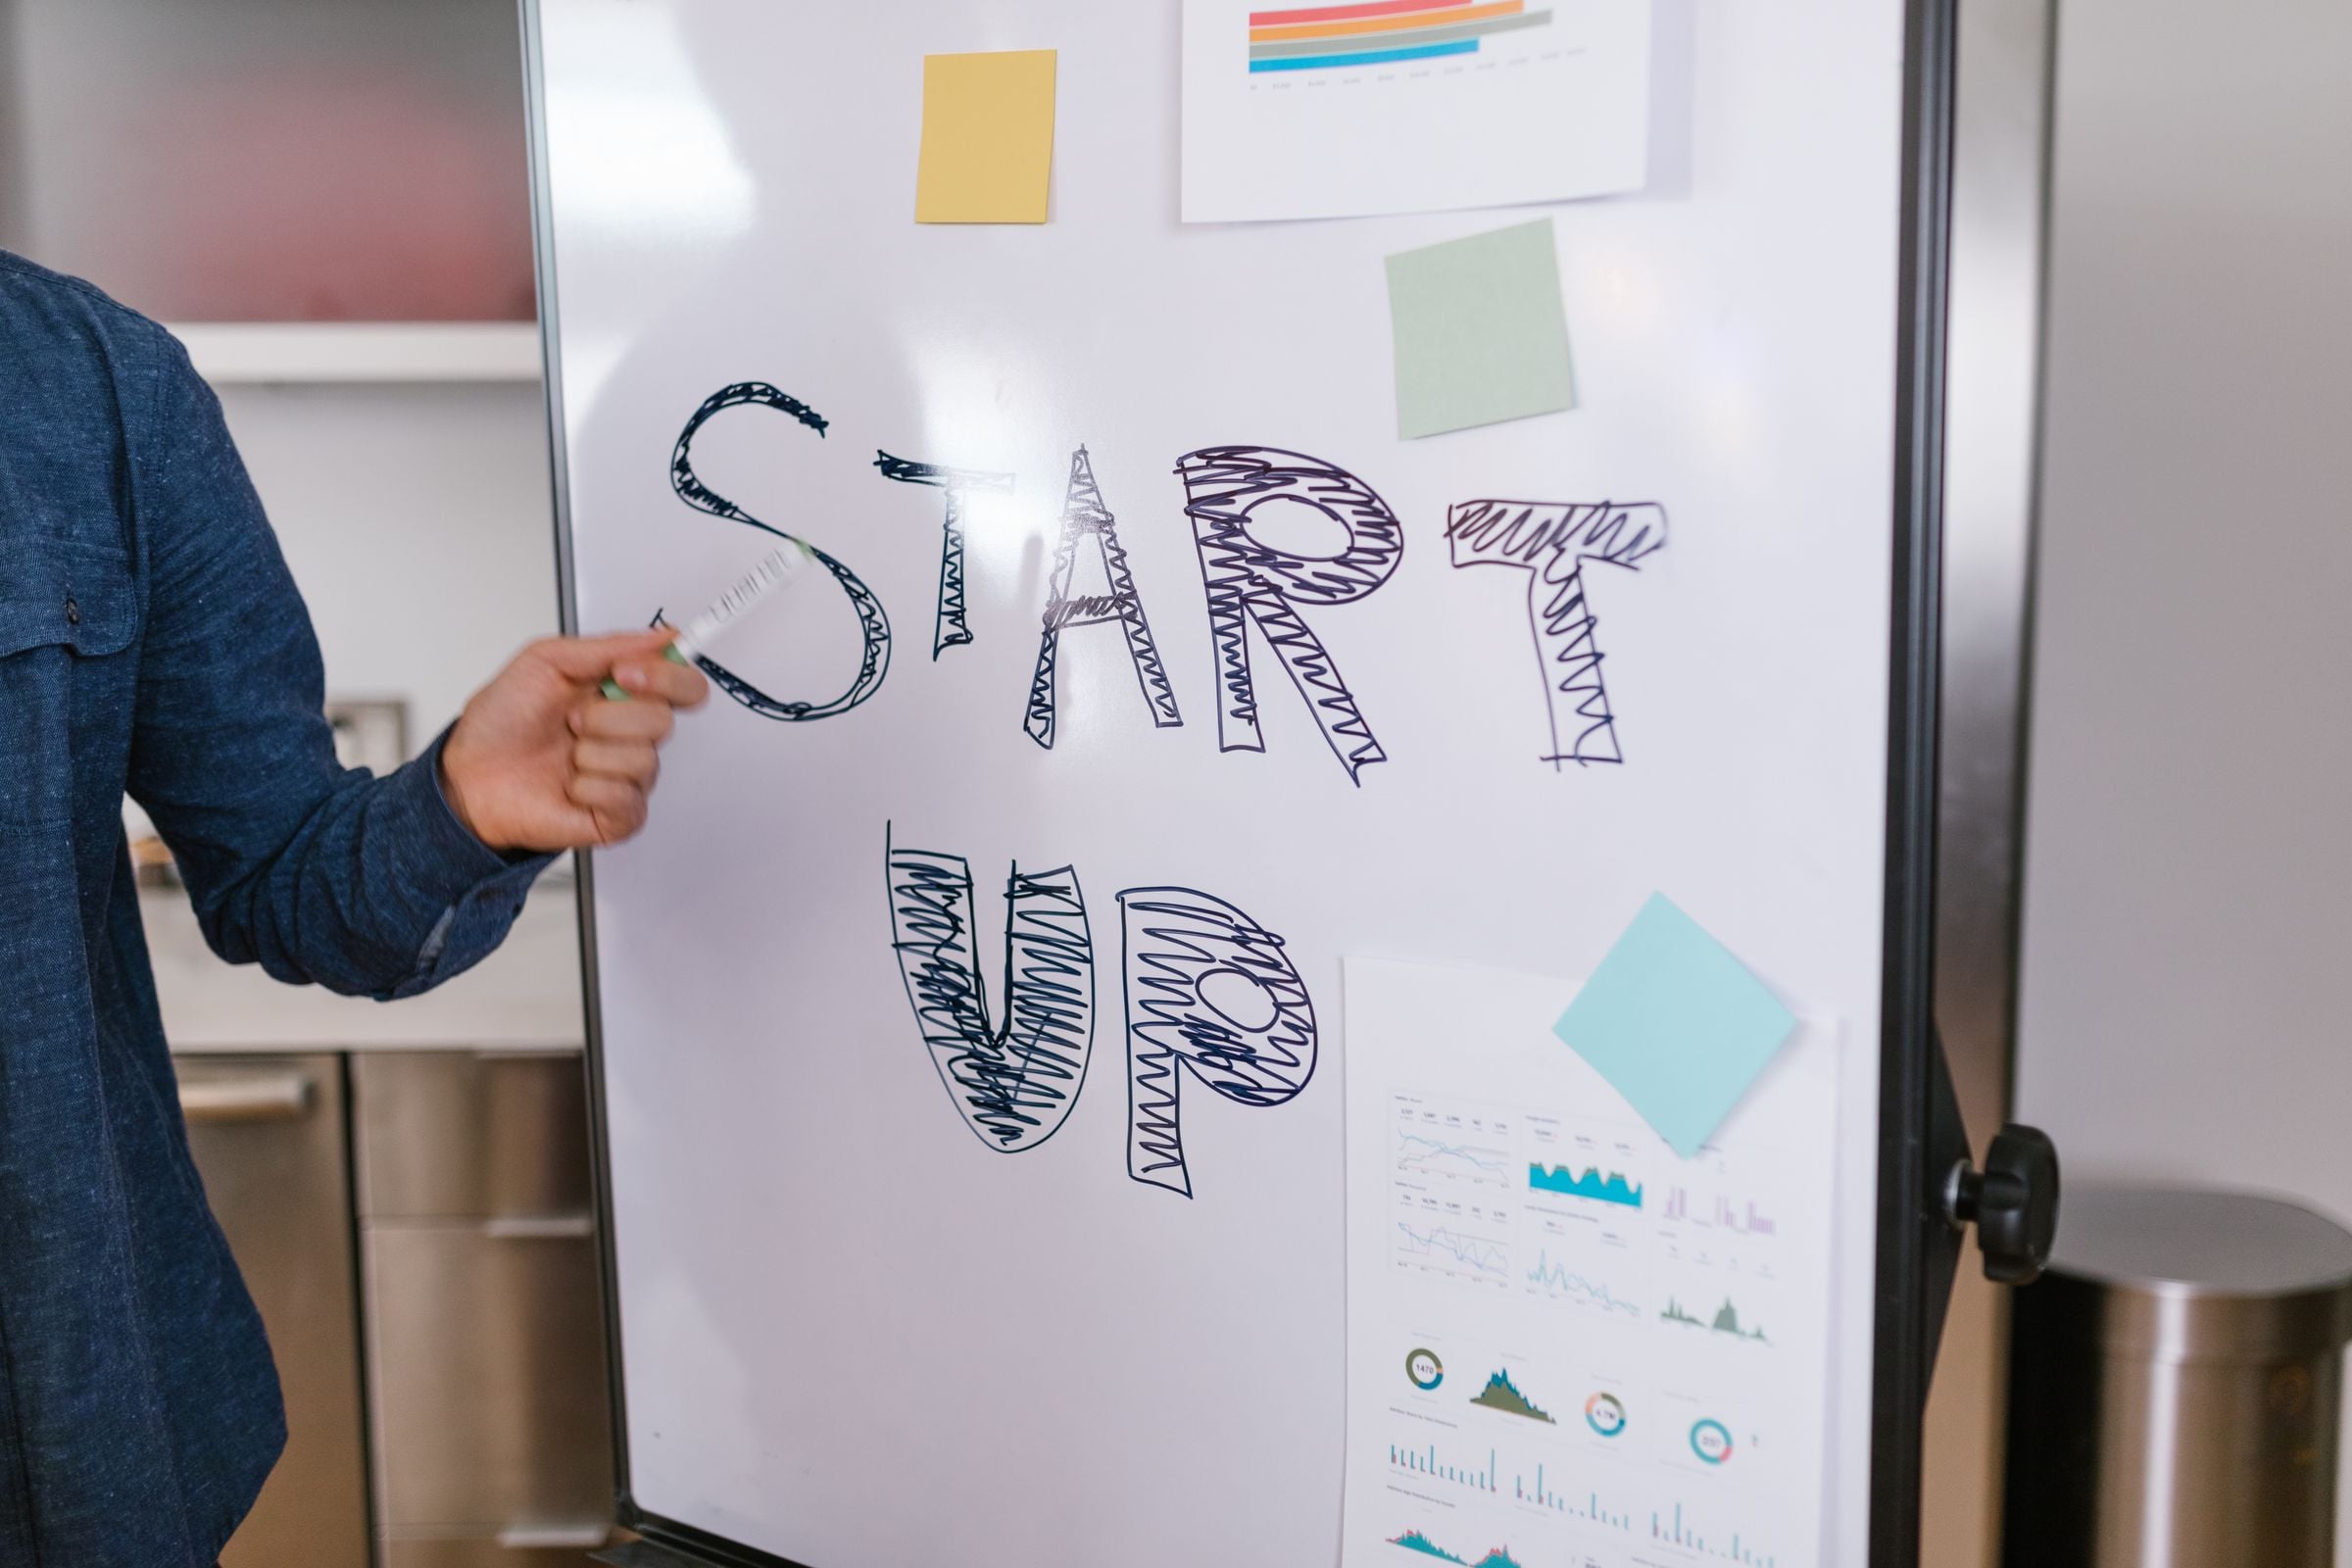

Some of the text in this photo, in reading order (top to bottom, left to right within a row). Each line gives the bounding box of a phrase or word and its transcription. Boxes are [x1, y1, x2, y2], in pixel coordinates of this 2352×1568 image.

[649, 381, 1668, 788] START
[886, 819, 1318, 1200] UP
[1416, 1363, 1435, 1375] 1470
